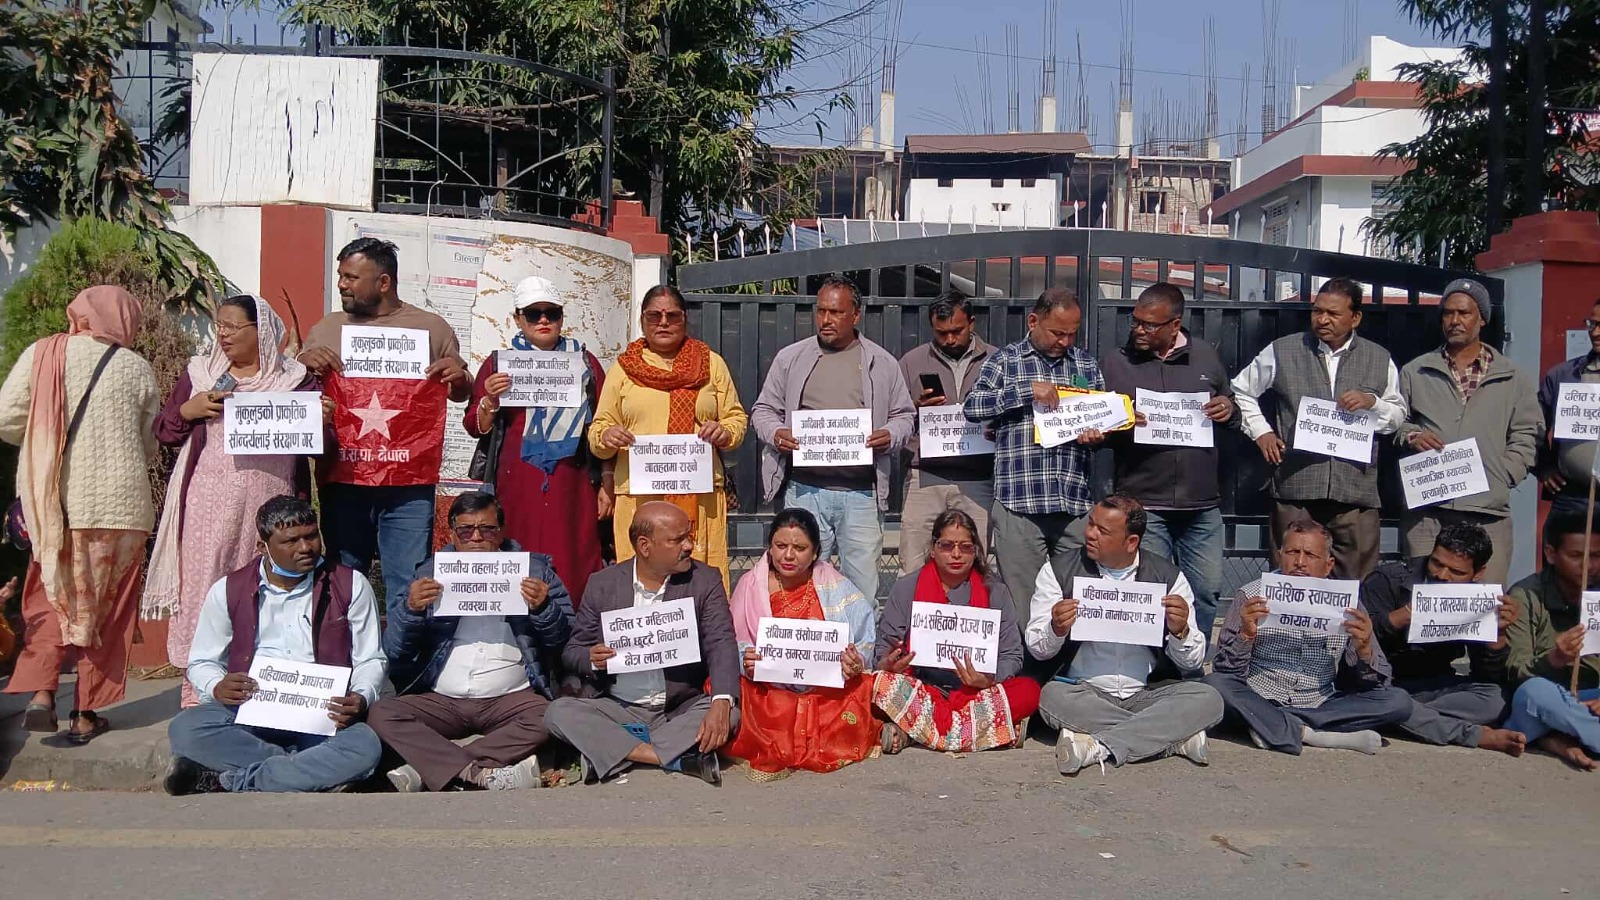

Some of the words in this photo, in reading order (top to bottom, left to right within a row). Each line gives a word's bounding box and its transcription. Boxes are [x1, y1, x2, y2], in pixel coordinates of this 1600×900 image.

[388, 334, 416, 354] प्राकृतिक
[345, 355, 382, 374] सौन्दर्यलाई
[384, 358, 409, 374] संरक्षण
[411, 362, 421, 374] गर
[559, 393, 568, 402] गर
[1564, 390, 1587, 401] दलित
[1590, 393, 1596, 402] र
[276, 400, 307, 423] प्राकृतिक
[1073, 400, 1108, 412] महिलाको
[1561, 405, 1581, 417] लागि
[1044, 417, 1062, 428] लागि
[1355, 415, 1369, 426] गरी
[1571, 422, 1587, 433] क्षेत्र
[928, 427, 939, 436] गरी
[1152, 428, 1171, 439] प्रणाली
[1184, 432, 1192, 441] गर
[1321, 425, 1343, 437] समस्या
[229, 429, 271, 449] सौन्दर्यलाई
[273, 430, 300, 449] संरक्षण
[302, 433, 314, 448] गर
[378, 445, 410, 462] नेपाल
[633, 442, 660, 455] स्थानीय
[662, 442, 687, 455] तहलाई
[689, 441, 705, 455] प्रदेश
[1327, 442, 1337, 452] गर
[802, 449, 824, 460] अधिकार
[851, 451, 859, 460] गर
[645, 462, 677, 473] मातहतमा
[679, 460, 697, 472] राख्ने
[652, 480, 677, 490] व्यवस्था
[680, 480, 691, 490] गर
[1410, 479, 1415, 487] र
[439, 560, 469, 574] स्थानीय
[472, 560, 499, 575] तहलाई
[502, 560, 520, 575] प्रदेश
[451, 582, 487, 593] मातहतमा
[490, 579, 510, 593] राख्ने
[1082, 585, 1119, 602] पहिचानको
[1308, 589, 1352, 608] स्वायत्तता
[458, 601, 487, 611] व्यवस्था
[490, 600, 502, 612] गर
[1416, 591, 1431, 613] शिक्षा
[1433, 597, 1438, 612] र
[609, 618, 634, 632] दलित
[636, 618, 644, 628] र
[645, 608, 684, 625] महिलाको
[1105, 608, 1143, 623] नामांकरण
[1143, 613, 1156, 624] गर
[1280, 614, 1312, 628] कायम
[1314, 617, 1330, 631] गर
[960, 617, 979, 634] राज्य
[1470, 620, 1481, 635] गर
[609, 636, 631, 649] लागि
[634, 631, 655, 648] छुट्टै
[656, 628, 689, 644] निर्वाचन
[824, 629, 838, 643] गरी
[624, 652, 641, 666] क्षेत्र
[644, 651, 664, 665] लागू
[665, 649, 678, 660] गर
[758, 644, 782, 662] राष्ट्रिय
[785, 648, 811, 660] समस्या
[813, 650, 843, 663] समाधान
[974, 648, 987, 664] गर
[259, 666, 299, 685] पहिचानको
[793, 668, 805, 680] गर
[279, 691, 320, 708] नामांकरण
